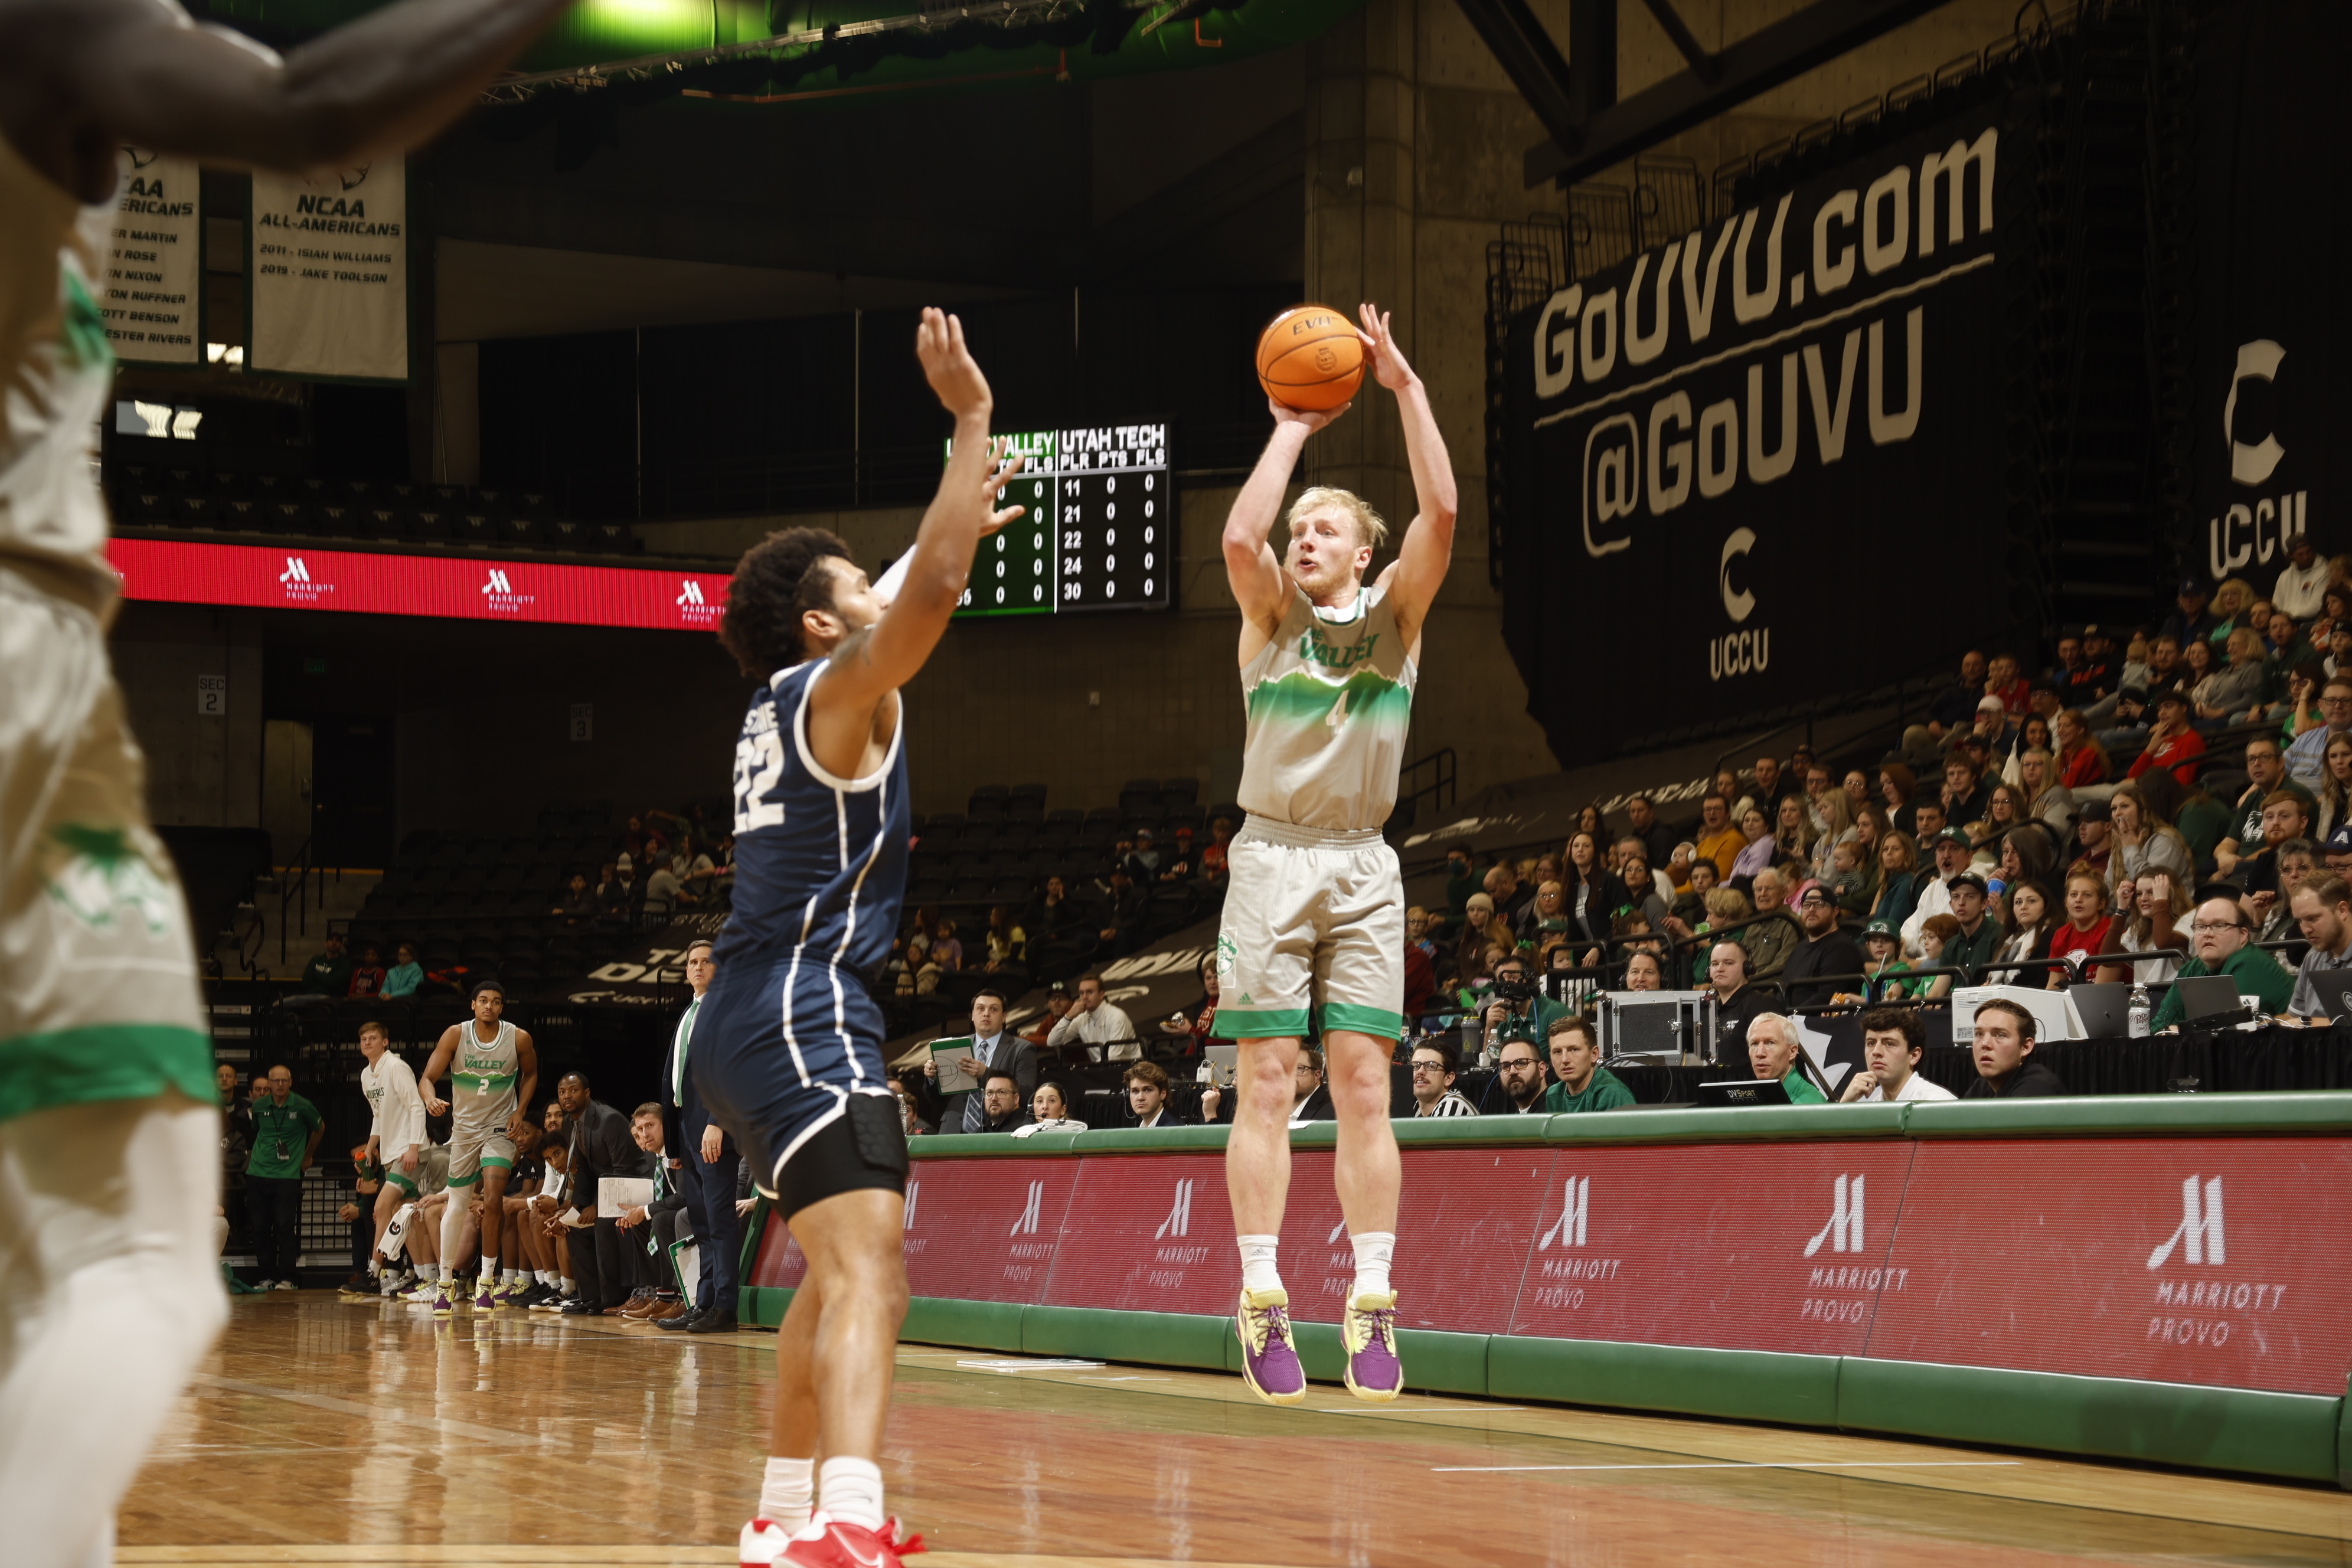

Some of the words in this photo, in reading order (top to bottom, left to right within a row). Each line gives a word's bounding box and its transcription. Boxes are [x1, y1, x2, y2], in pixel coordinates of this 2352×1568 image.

[296, 194, 364, 217] NCAA
[259, 213, 400, 236] ALL-AMERICANS
[130, 230, 178, 243] MARTIN
[124, 249, 156, 261] ROSE
[260, 244, 286, 255] 2011
[298, 248, 329, 259] ISIAH
[332, 250, 391, 263] WILLIAMS
[1534, 126, 1998, 399] GoUVU.com
[125, 270, 162, 282] NIXON
[260, 264, 288, 275] 2019
[300, 268, 329, 279] JAKE
[333, 271, 387, 282] TOOLSON
[131, 290, 186, 303] RUFFNER
[129, 311, 179, 324] BENSON
[148, 332, 192, 344] RIVERS
[1063, 427, 1112, 453] UTAH
[1115, 423, 1164, 450] TECH
[1583, 305, 1922, 557] @GoUVU
[1024, 456, 1054, 475] FLS
[1060, 452, 1089, 471] PLR
[1099, 450, 1128, 469] PTS
[1136, 447, 1165, 466] FLS
[1034, 481, 1043, 498] 0
[1065, 478, 1080, 497] 11
[1106, 476, 1116, 494] 0
[1145, 473, 1154, 492] 0
[1034, 507, 1043, 524] 0
[1064, 504, 1080, 523] 21
[1106, 502, 1115, 520] 0
[1145, 499, 1154, 518] 0
[997, 534, 1005, 552] 0
[1034, 533, 1043, 550] 0
[1064, 530, 1082, 549] 22
[1106, 528, 1115, 546] 0
[1145, 525, 1154, 544] 0
[997, 560, 1005, 578] 0
[1034, 558, 1043, 576] 0
[1064, 556, 1082, 575] 24
[1106, 554, 1115, 573] 0
[1144, 552, 1154, 570] 0
[996, 586, 1005, 604] 0
[1034, 584, 1043, 602] 0
[1064, 582, 1082, 600] 30
[1106, 580, 1115, 599] 0
[1144, 578, 1154, 596] 0
[1710, 627, 1769, 681] UCCU
[200, 678, 224, 690] SEC
[206, 693, 217, 711] 2
[1325, 689, 1350, 734] 4
[464, 1059, 507, 1069] VALLEY
[477, 1079, 489, 1096] 2
[902, 1239, 927, 1254] RIOTT
[1009, 1242, 1054, 1259] MARRIOTT
[1155, 1246, 1209, 1265] MARRIOTT
[1003, 1265, 1031, 1282] PROVO
[1541, 1258, 1621, 1280] MARRIOTT
[1149, 1270, 1183, 1288] PROVO
[1808, 1266, 1909, 1292] MARRIOTT
[1534, 1287, 1584, 1309] PROVO
[2155, 1280, 2287, 1311] MARRIOTT
[1800, 1298, 1864, 1324] PROVO
[2147, 1318, 2230, 1347] PROVO
